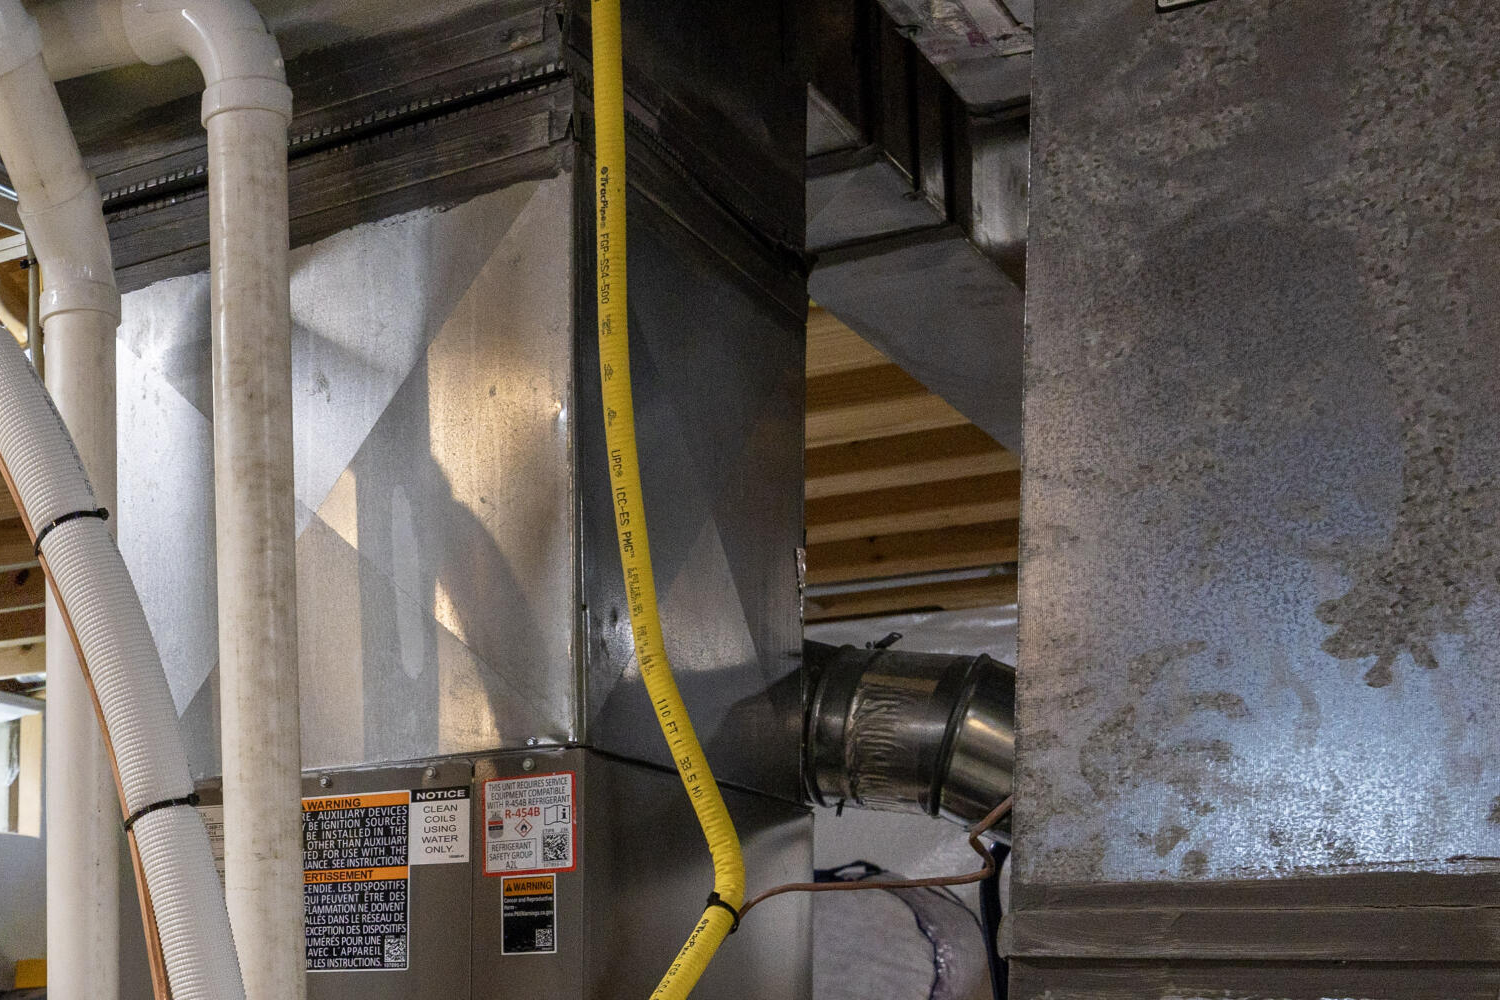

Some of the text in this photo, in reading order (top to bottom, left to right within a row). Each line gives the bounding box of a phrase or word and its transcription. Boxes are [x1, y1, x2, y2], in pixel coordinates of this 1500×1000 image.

[657, 698, 671, 718] 110
[666, 721, 678, 734] FT
[488, 777, 568, 792] THIS UNIT REQUIRES SERVICE
[416, 789, 466, 800] NOTICE
[491, 786, 565, 800] EQUIPMENT COMPATIBLE
[308, 798, 361, 810] WARNING
[487, 801, 503, 809] WITH
[528, 795, 570, 806] REFRIGERANT
[318, 806, 408, 821] AUXILIARY DEVICES
[423, 804, 458, 813] CLEAN
[505, 807, 540, 819] R-454B
[308, 816, 407, 830] BE IGNITION SOURCES
[424, 815, 456, 823] COILS
[306, 826, 407, 841] BE INSTALLED IN THE
[424, 825, 457, 833] USING
[307, 835, 408, 850] OTHER THAN AUXILIARY
[421, 835, 459, 844] WATER
[323, 845, 407, 859] FOR USE WITH THE
[425, 845, 454, 854] ONLY.
[491, 842, 532, 851] REFRIGERANT
[331, 855, 408, 868] SEE INSTRUCTIONS.
[489, 851, 533, 861] SAFETY GROUP
[304, 870, 374, 881] ERTISSEMENT
[338, 882, 352, 893] LES
[354, 880, 406, 892] DISPOSITIFS
[513, 881, 552, 891] WARNING
[303, 890, 406, 905] QUI PEUVENT ÊTRE DES
[358, 904, 369, 913] NE
[371, 902, 405, 912] DOIVENT
[328, 914, 349, 925] DANS
[351, 914, 360, 923] LE
[361, 912, 392, 923] RÉSEAU
[394, 912, 405, 922] DE
[346, 925, 361, 934] DES
[362, 923, 406, 934] DISPOSITIFS
[341, 936, 363, 946] POUR
[365, 935, 382, 945] UNE
[308, 948, 329, 957] AVEC
[314, 958, 326, 968] LES
[327, 957, 382, 968] INSTRUCTIONS.
